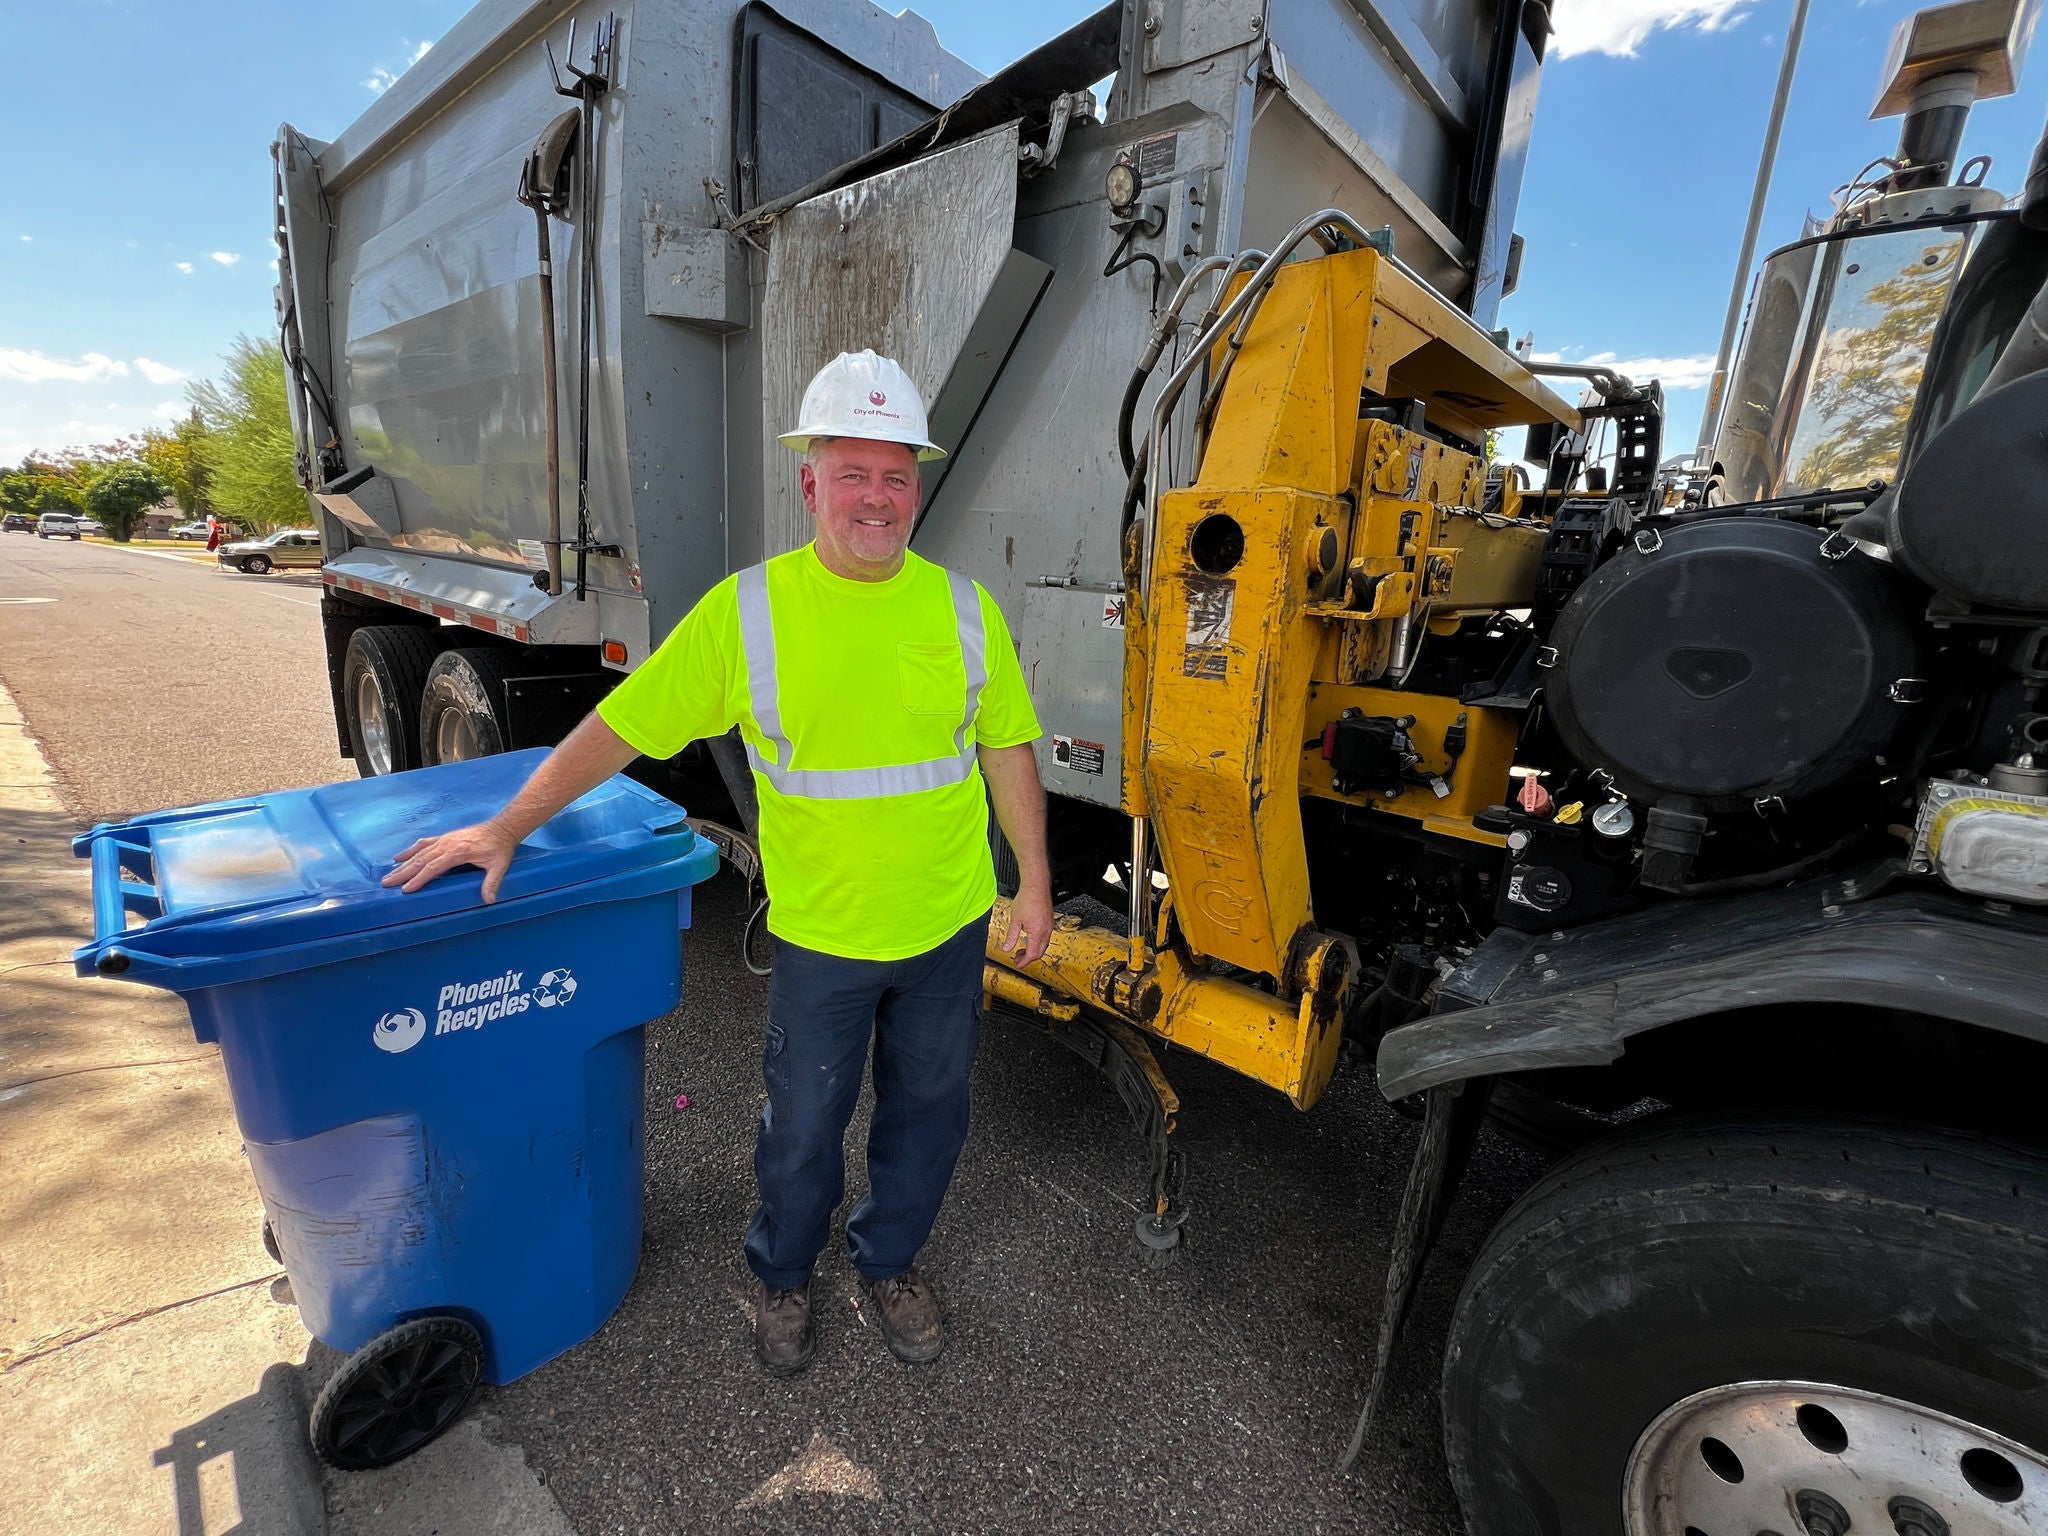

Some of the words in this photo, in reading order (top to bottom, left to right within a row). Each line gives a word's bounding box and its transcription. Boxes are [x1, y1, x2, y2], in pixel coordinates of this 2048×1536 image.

[853, 408, 867, 416] City
[875, 411, 900, 419] Phoenix
[437, 970, 524, 1011] Phoenix
[434, 993, 531, 1036] Recycles
